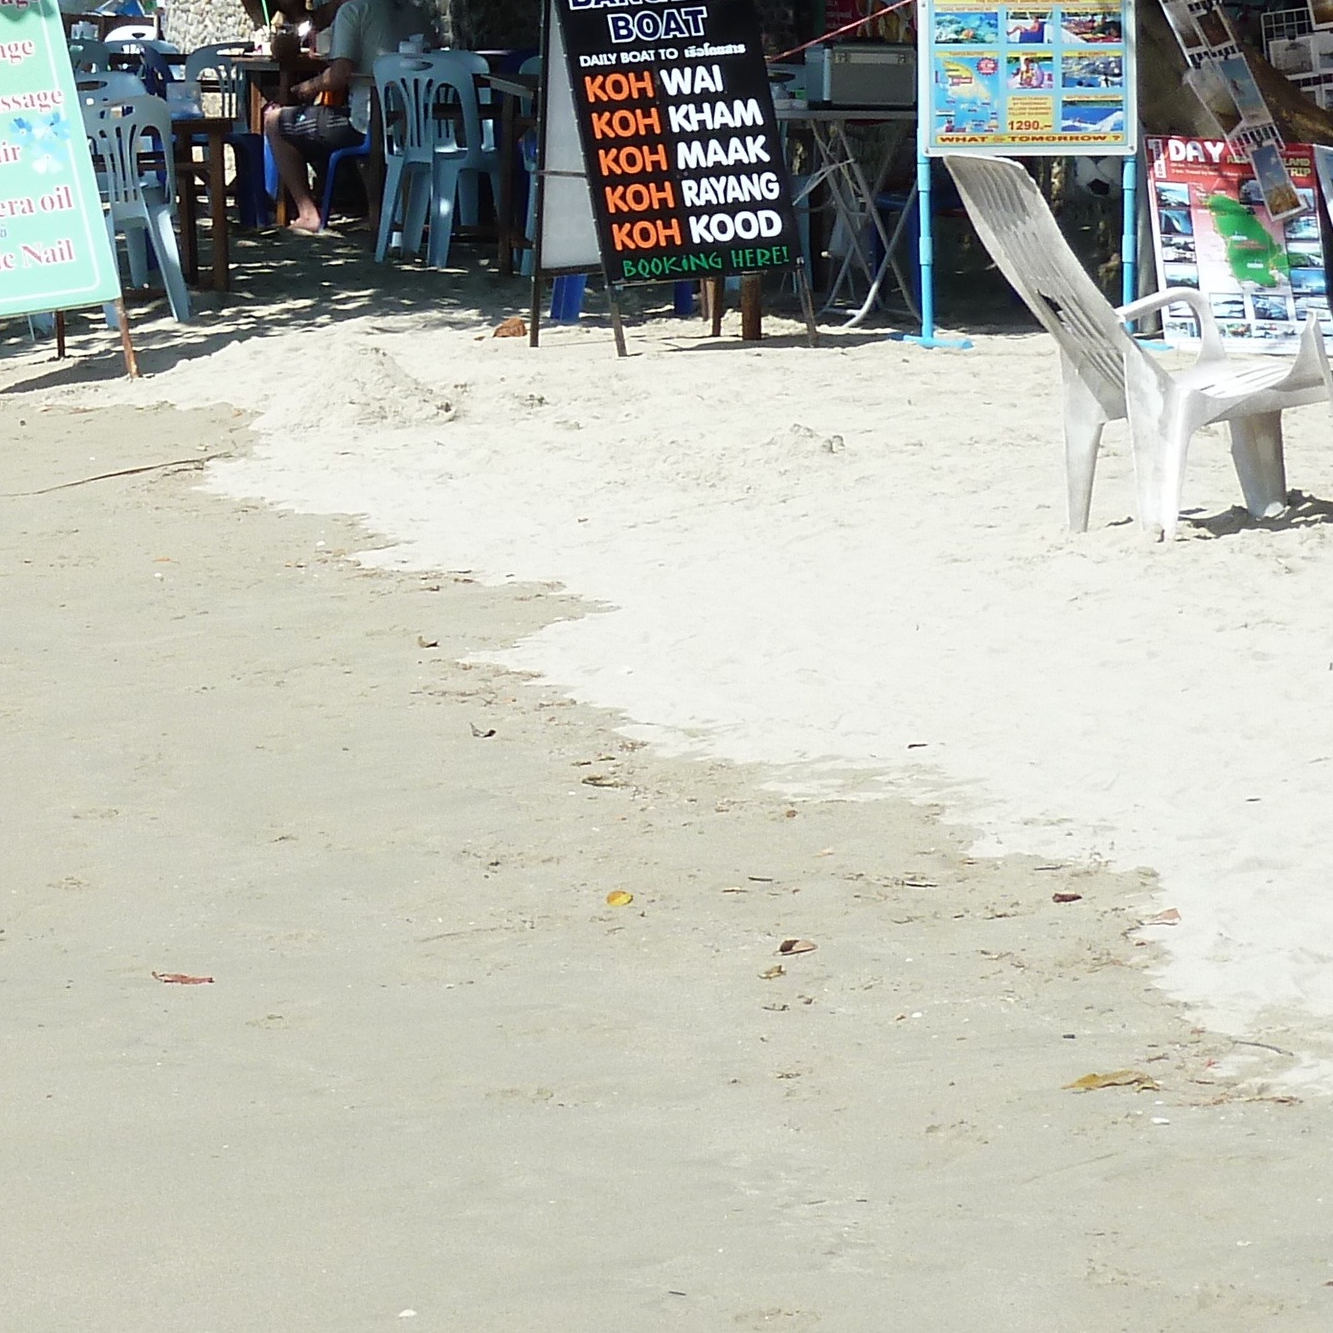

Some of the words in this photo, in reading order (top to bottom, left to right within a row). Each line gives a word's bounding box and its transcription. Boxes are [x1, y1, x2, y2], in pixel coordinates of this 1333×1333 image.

[607, 6, 708, 44] BOAT
[579, 52, 618, 67] DAILY
[620, 49, 656, 64] BOAT
[658, 47, 679, 60] TO
[584, 70, 655, 103] KOH
[659, 64, 724, 96] WAI
[591, 107, 662, 140] KOH
[668, 98, 764, 133] KHAM
[1010, 134, 1107, 142] TOMORROW
[1167, 139, 1225, 163] DAY
[598, 143, 669, 177] KOH
[677, 134, 771, 170] MAAK
[39, 186, 74, 212] oil
[605, 180, 675, 214] KOH
[681, 171, 780, 208] RAYANG
[611, 218, 682, 251] KOH
[688, 209, 783, 244] KOOD
[22, 239, 75, 267] Nail
[731, 245, 790, 269] HERE!
